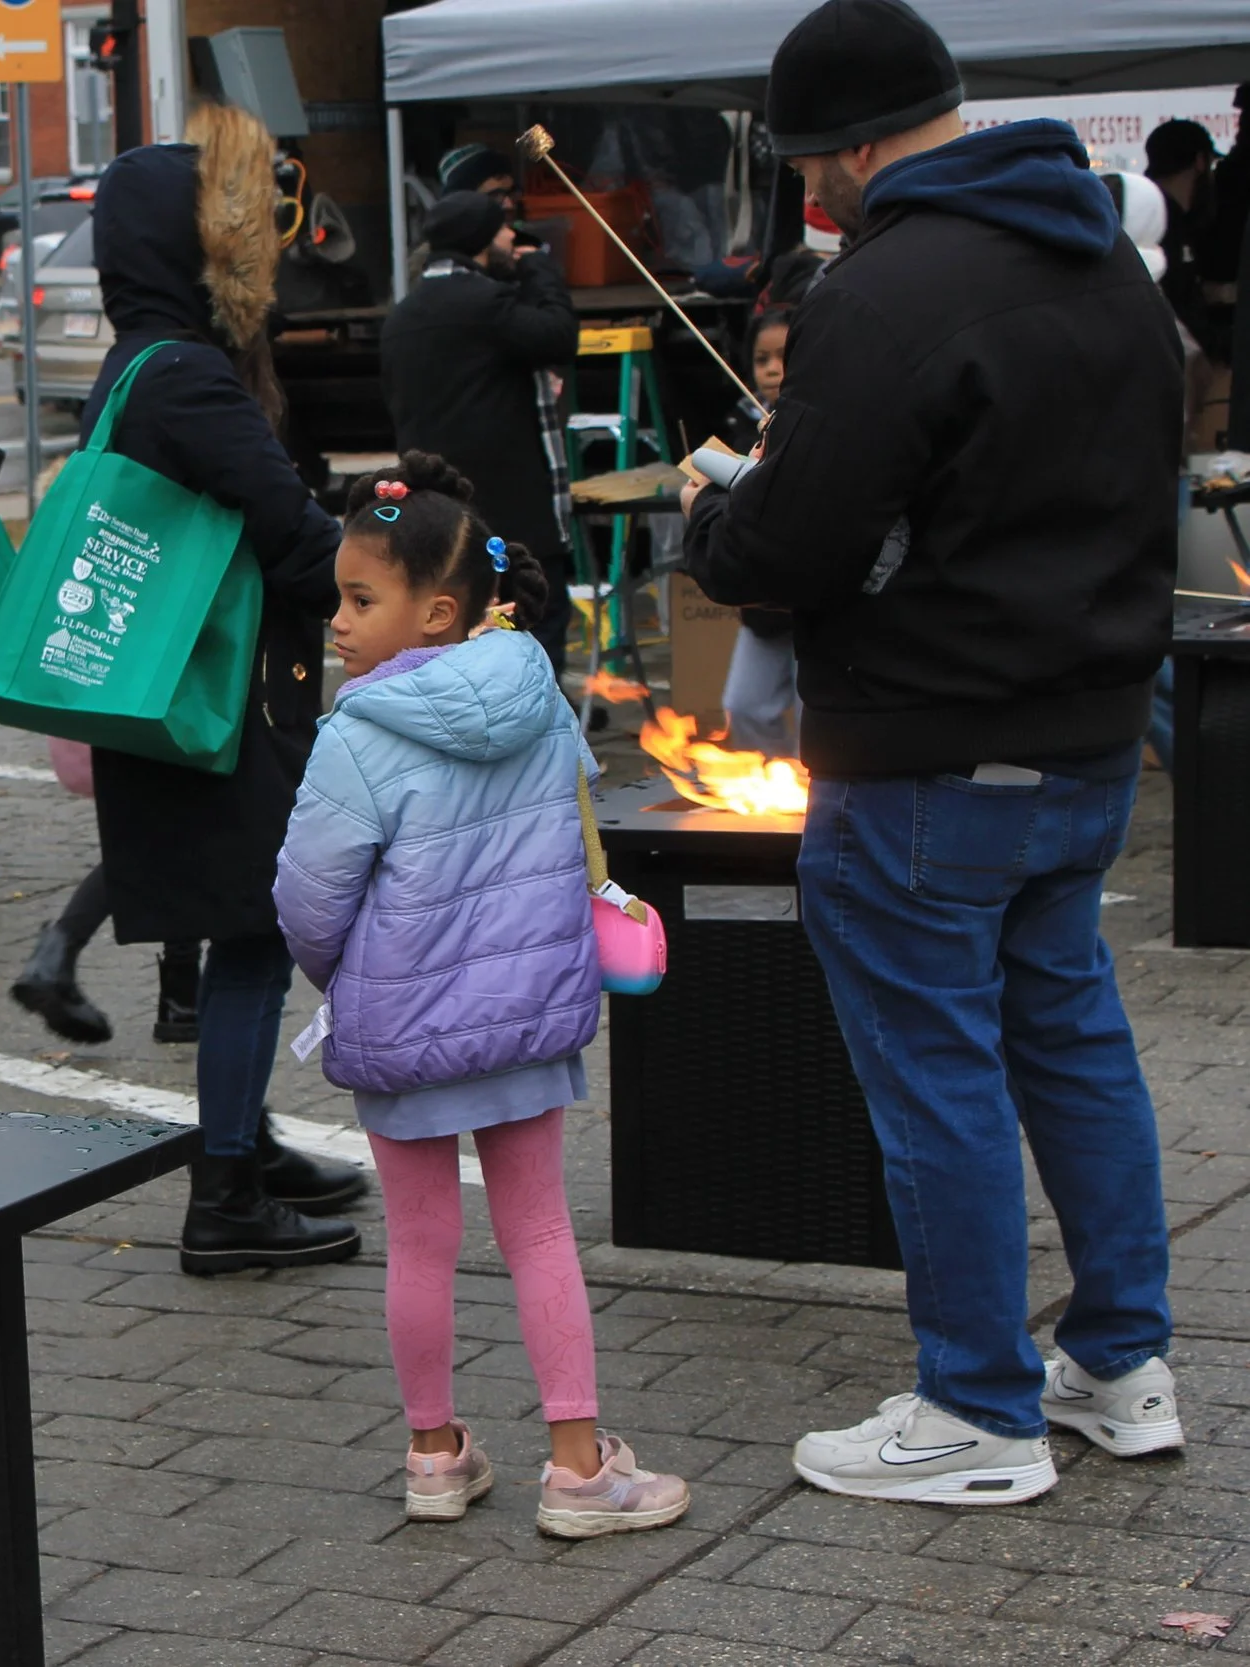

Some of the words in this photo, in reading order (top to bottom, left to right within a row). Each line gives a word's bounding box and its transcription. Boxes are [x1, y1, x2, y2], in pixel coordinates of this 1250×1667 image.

[81, 548, 113, 570] Pumping
[112, 564, 121, 573] &
[121, 567, 144, 582] Drain
[84, 536, 148, 575] SERVICE
[89, 572, 116, 590] Austin
[117, 583, 138, 600] Prep
[54, 615, 121, 647] ALLPEOPLE
[88, 661, 111, 673] GROUP
